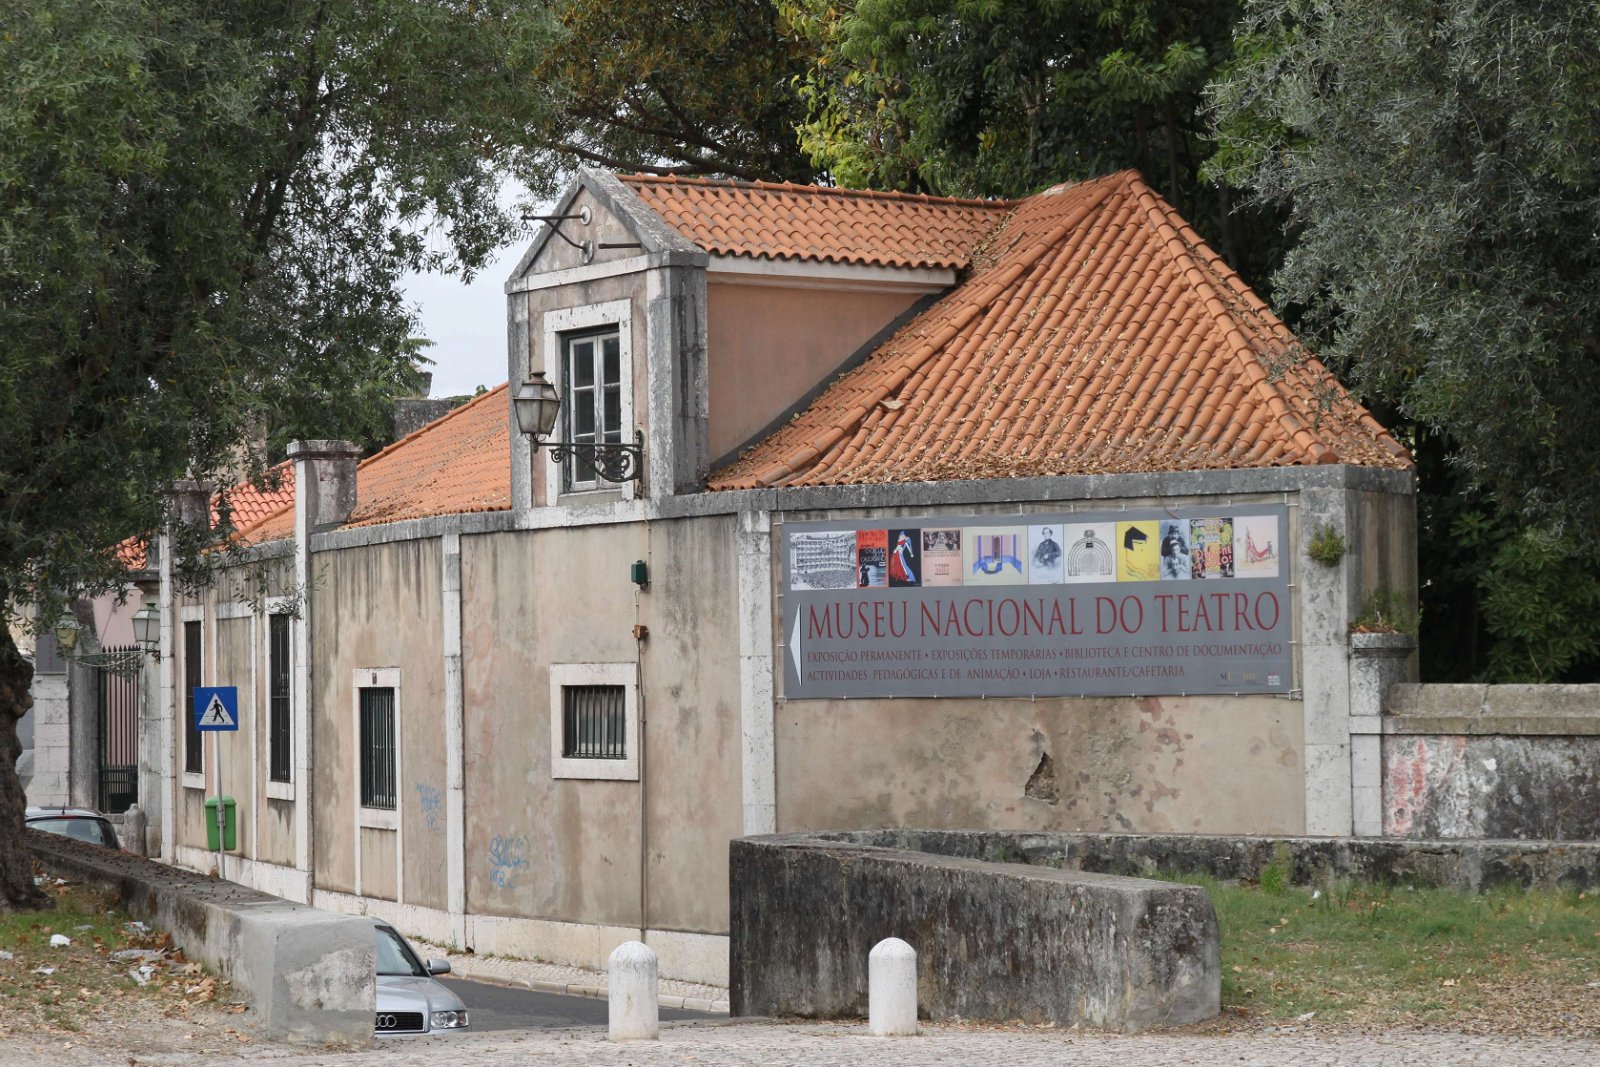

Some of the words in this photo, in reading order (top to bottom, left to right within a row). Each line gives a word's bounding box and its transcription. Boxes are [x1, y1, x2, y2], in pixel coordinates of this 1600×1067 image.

[807, 600, 908, 640] MUSEU
[920, 597, 1083, 638] NACIONAL
[1095, 595, 1144, 635] DO
[1154, 591, 1280, 633] TEATRO
[807, 650, 858, 664] EXPOSIÇÃO
[861, 649, 922, 662] PERMANENTE
[931, 647, 988, 662] EXPOSIÇÕES
[991, 646, 1057, 661] TEMPORÁRIAS
[1064, 646, 1121, 659] BIBLIOTECA
[1124, 646, 1129, 657] E
[1132, 645, 1174, 658] CENTRO
[1177, 645, 1190, 657] DE
[1193, 643, 1282, 658] DOCUMENTAÇÃO
[807, 669, 868, 681] ACTIVIDADES
[873, 667, 939, 680] PEDAGÓGICAS
[941, 668, 947, 679] E
[949, 668, 961, 680] DE
[967, 666, 1020, 681] ANIMAÇÃO
[1029, 667, 1051, 681] LOJA
[1060, 665, 1185, 679] RESTAURANTE/CAFETARIA
